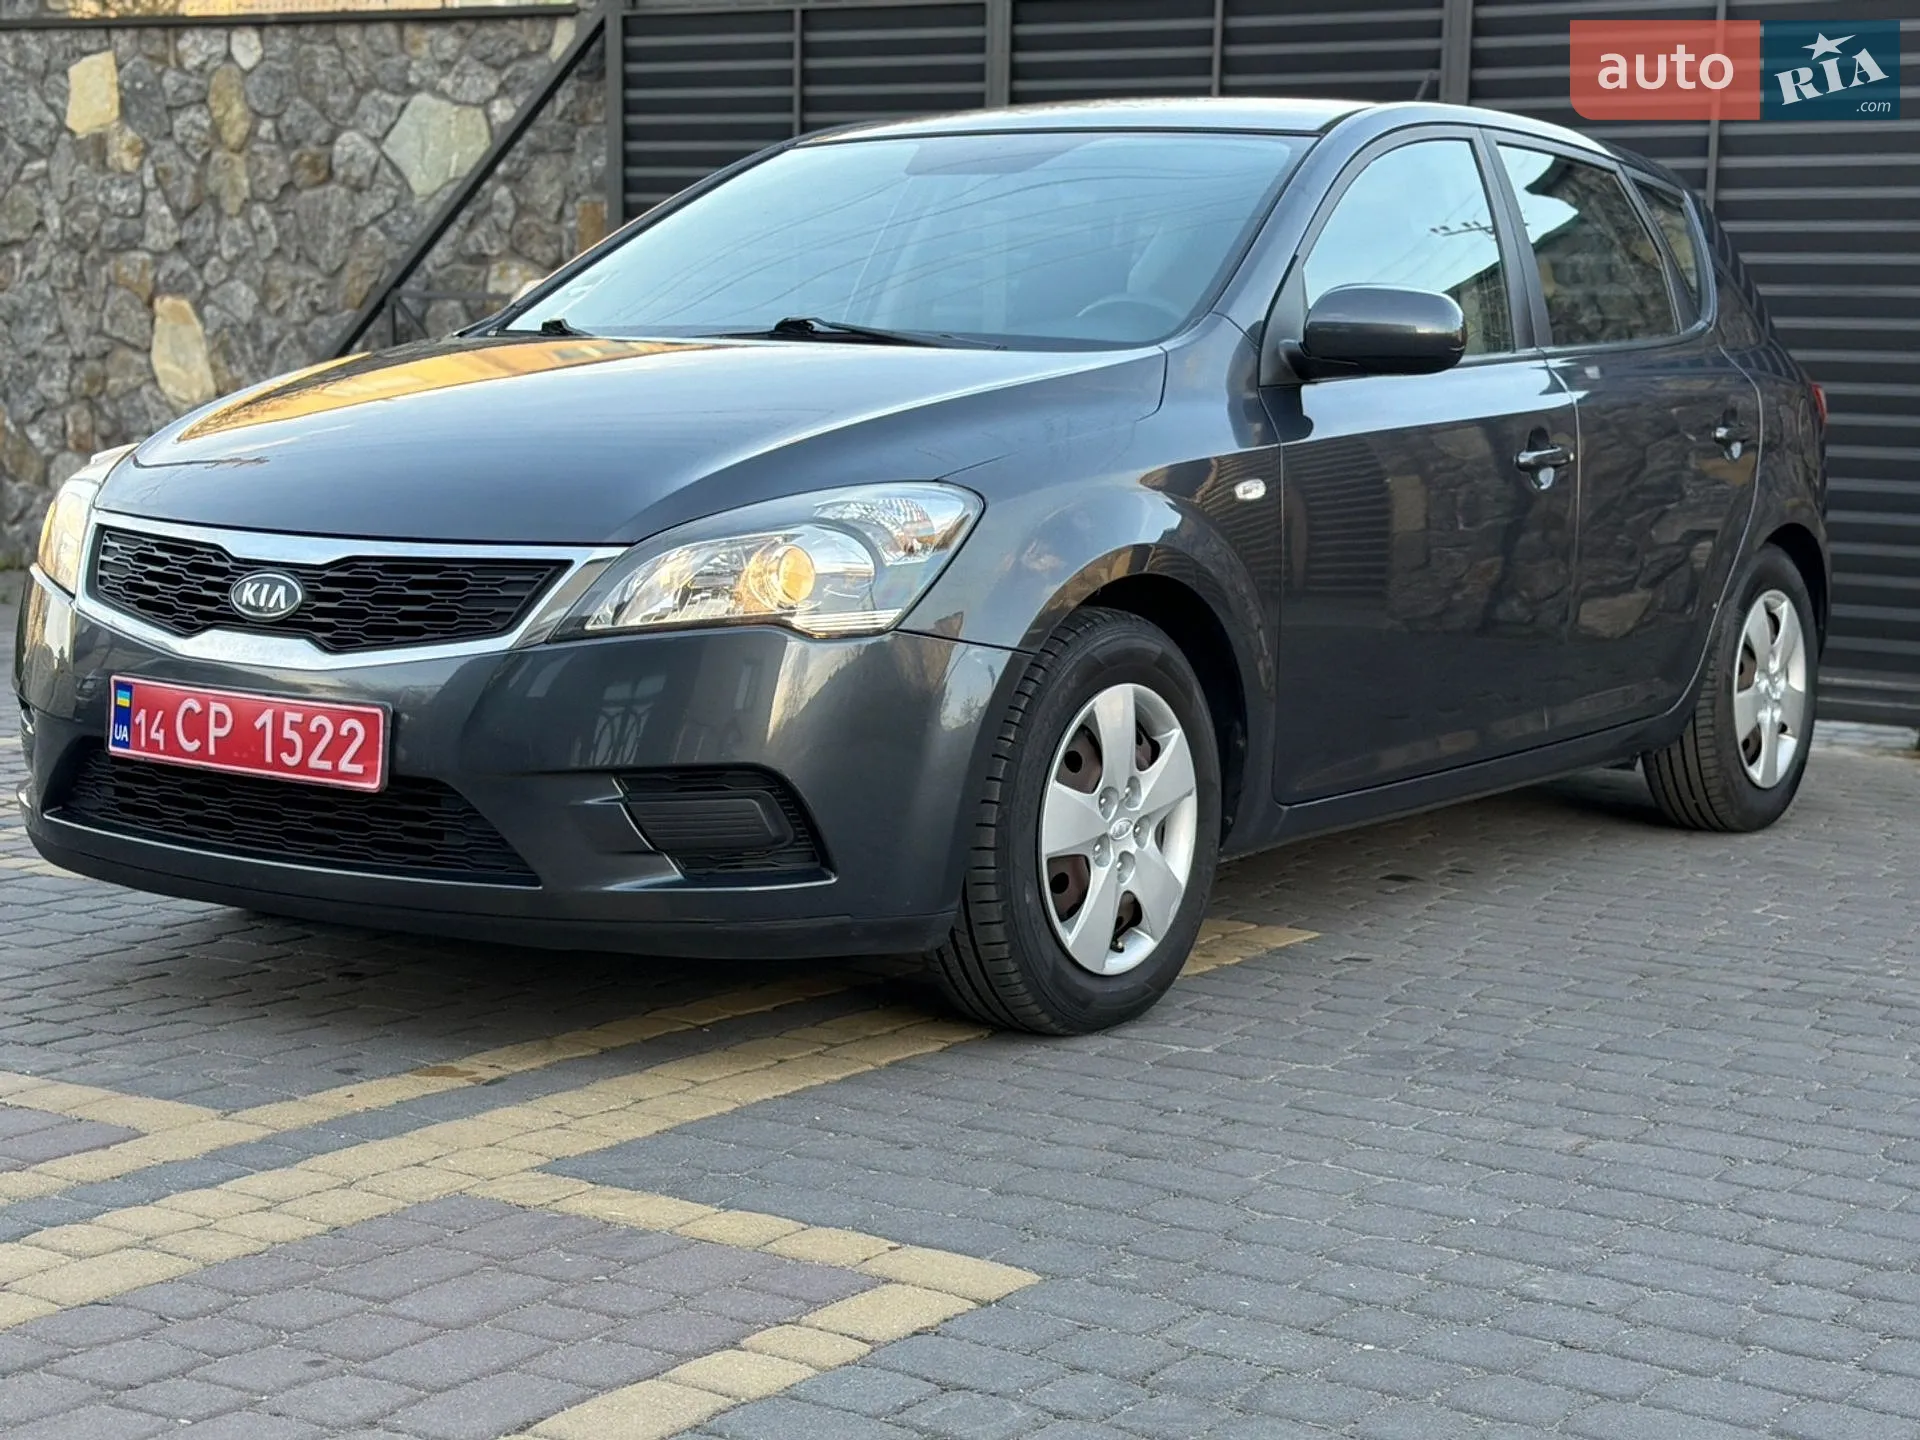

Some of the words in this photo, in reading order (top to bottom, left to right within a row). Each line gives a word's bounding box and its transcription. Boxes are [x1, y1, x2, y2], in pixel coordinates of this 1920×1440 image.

[242, 582, 286, 609] KIA
[114, 723, 129, 742] UA
[254, 708, 366, 774] 1522
